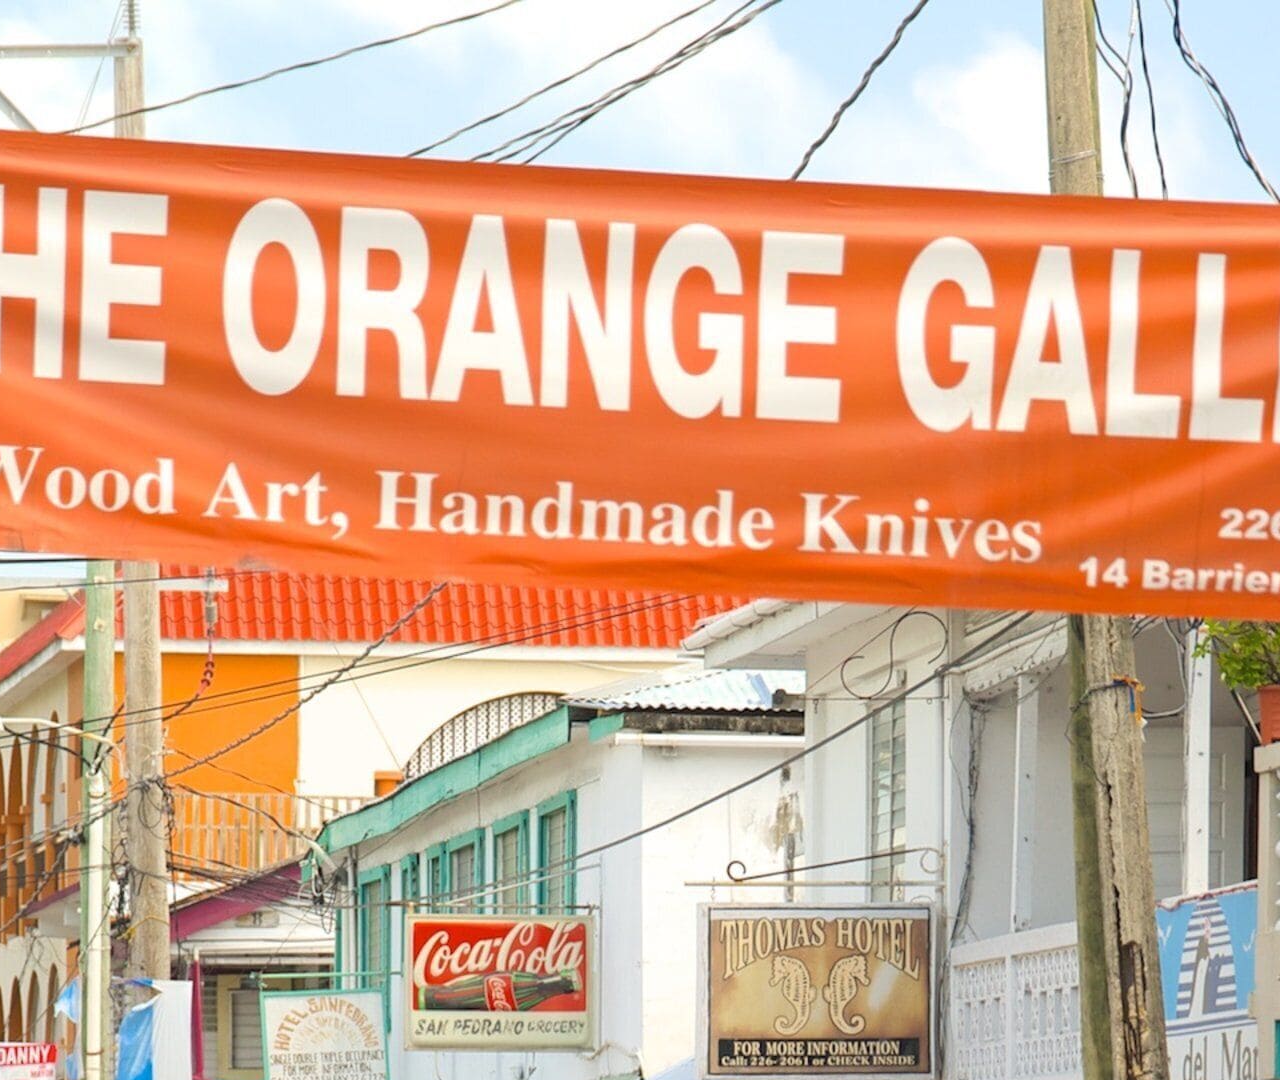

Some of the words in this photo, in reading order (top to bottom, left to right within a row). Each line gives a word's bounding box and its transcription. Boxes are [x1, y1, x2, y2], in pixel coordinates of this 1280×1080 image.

[222, 197, 846, 424] ORANGE
[202, 460, 351, 539] Art,
[375, 470, 775, 550] Handmade
[799, 491, 1043, 563] Knives
[1079, 556, 1129, 589] 14
[414, 921, 585, 987] Coca-Cola
[720, 917, 826, 980] THOMAS
[835, 917, 920, 981] HOTEL
[273, 1006, 309, 1051] HOTEL
[415, 1018, 447, 1036] SAN
[733, 1041, 761, 1056] FOR
[766, 1041, 805, 1056] MORE
[806, 1040, 900, 1056] INFORMATION
[721, 1056, 748, 1066] Call:
[812, 1058, 826, 1066] or
[827, 1056, 870, 1066] CHECK
[872, 1056, 916, 1066] INSIDE
